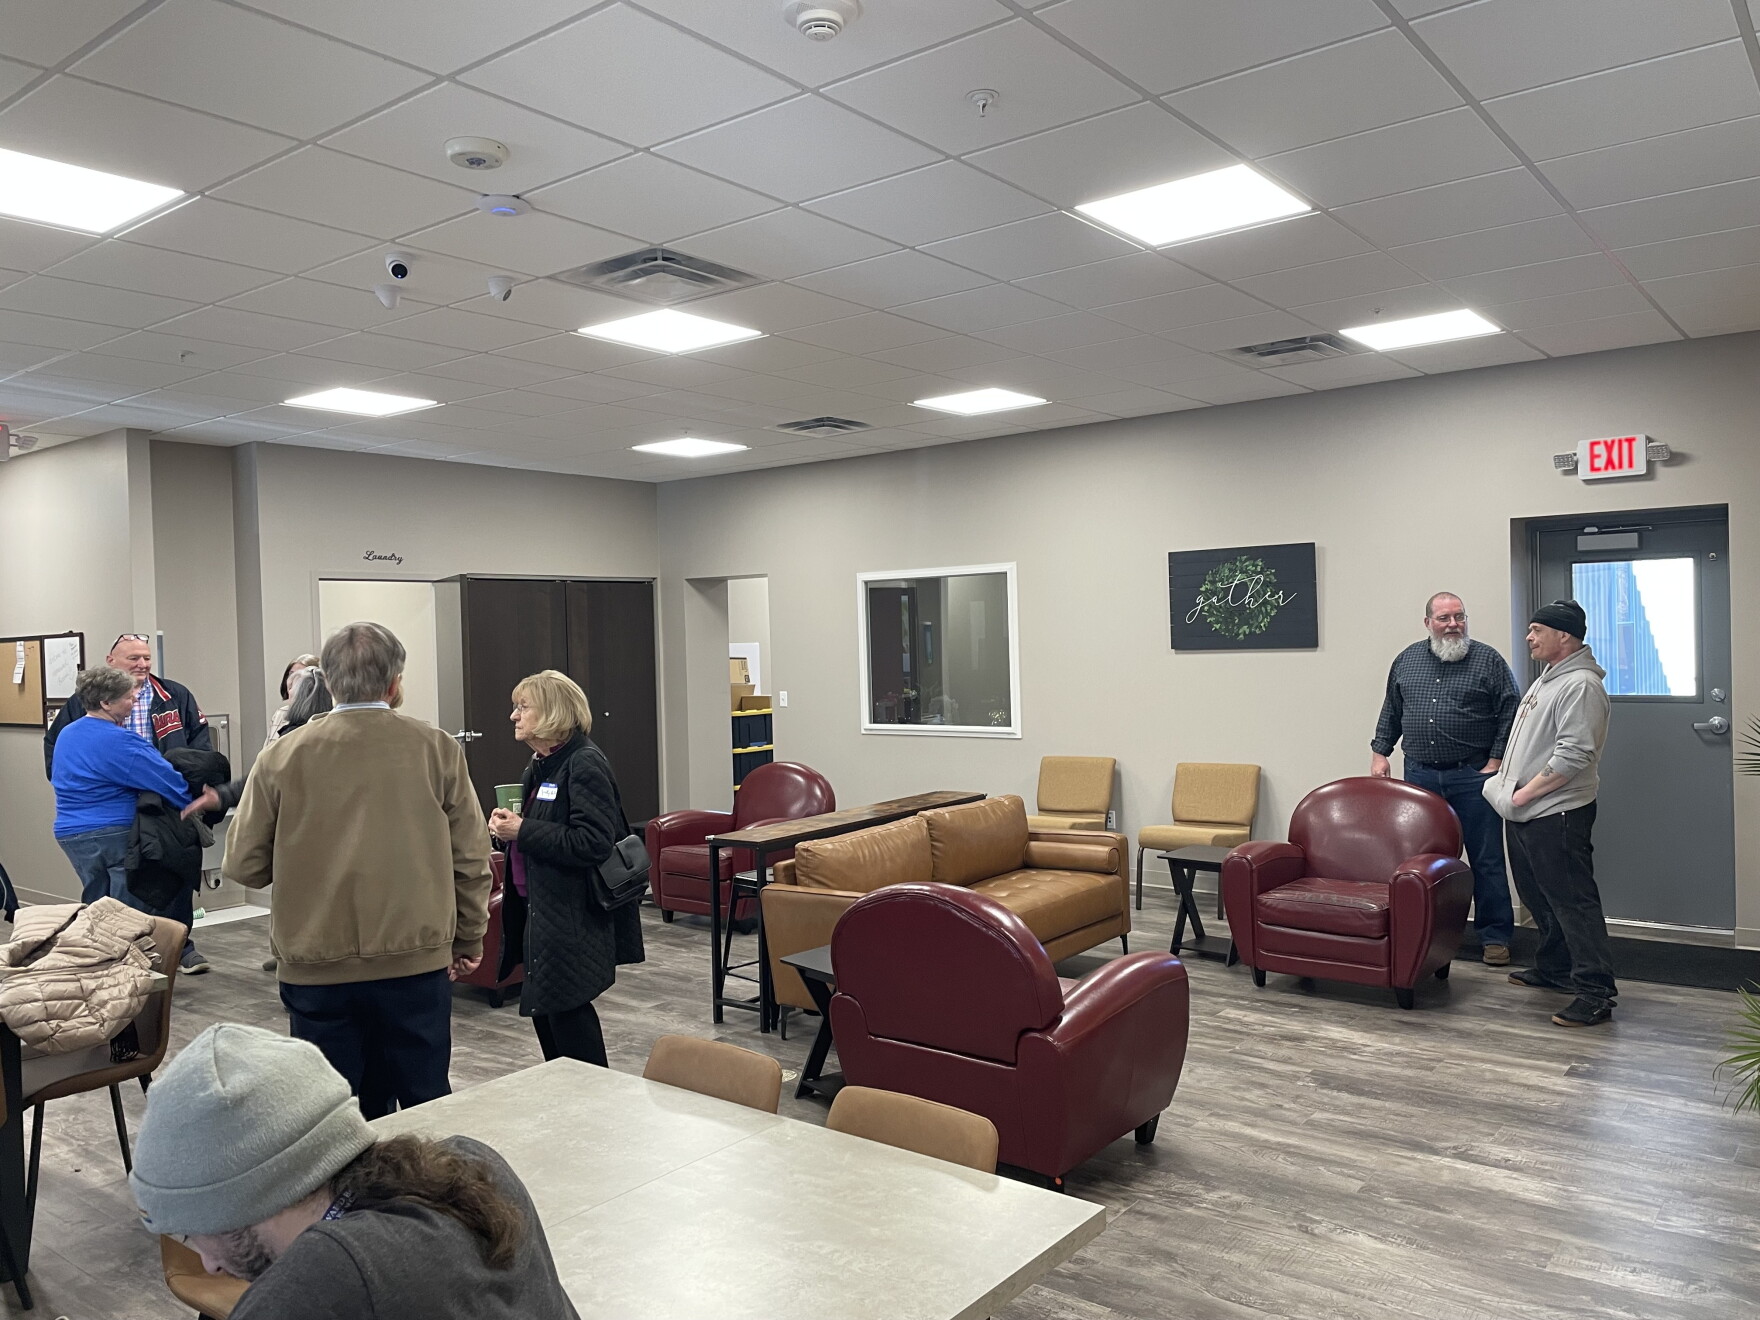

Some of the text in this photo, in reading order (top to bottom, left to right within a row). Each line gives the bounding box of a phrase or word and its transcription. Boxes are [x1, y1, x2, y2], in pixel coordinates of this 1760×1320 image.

[1589, 437, 1637, 472] EXIT
[363, 550, 403, 565] Laundry
[1185, 574, 1297, 623] gather
